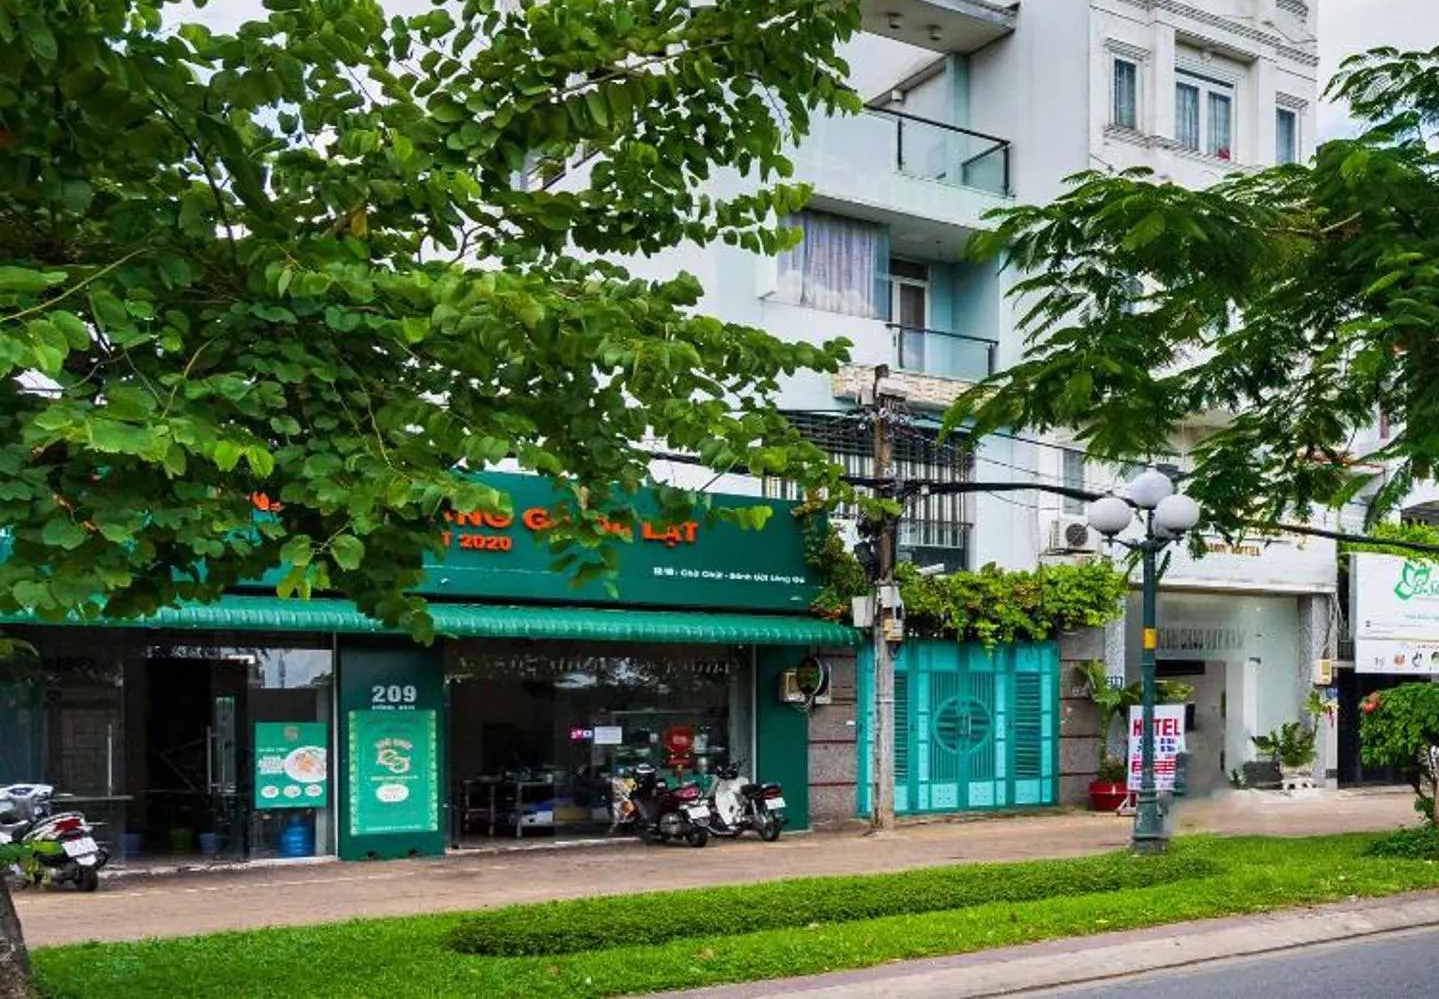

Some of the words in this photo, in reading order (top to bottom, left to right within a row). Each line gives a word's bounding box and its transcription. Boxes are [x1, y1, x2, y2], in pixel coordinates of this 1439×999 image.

[459, 533, 512, 551] 2020
[641, 521, 699, 547] LẠT
[371, 685, 417, 703] 209
[1133, 718, 1181, 737] HTEL
